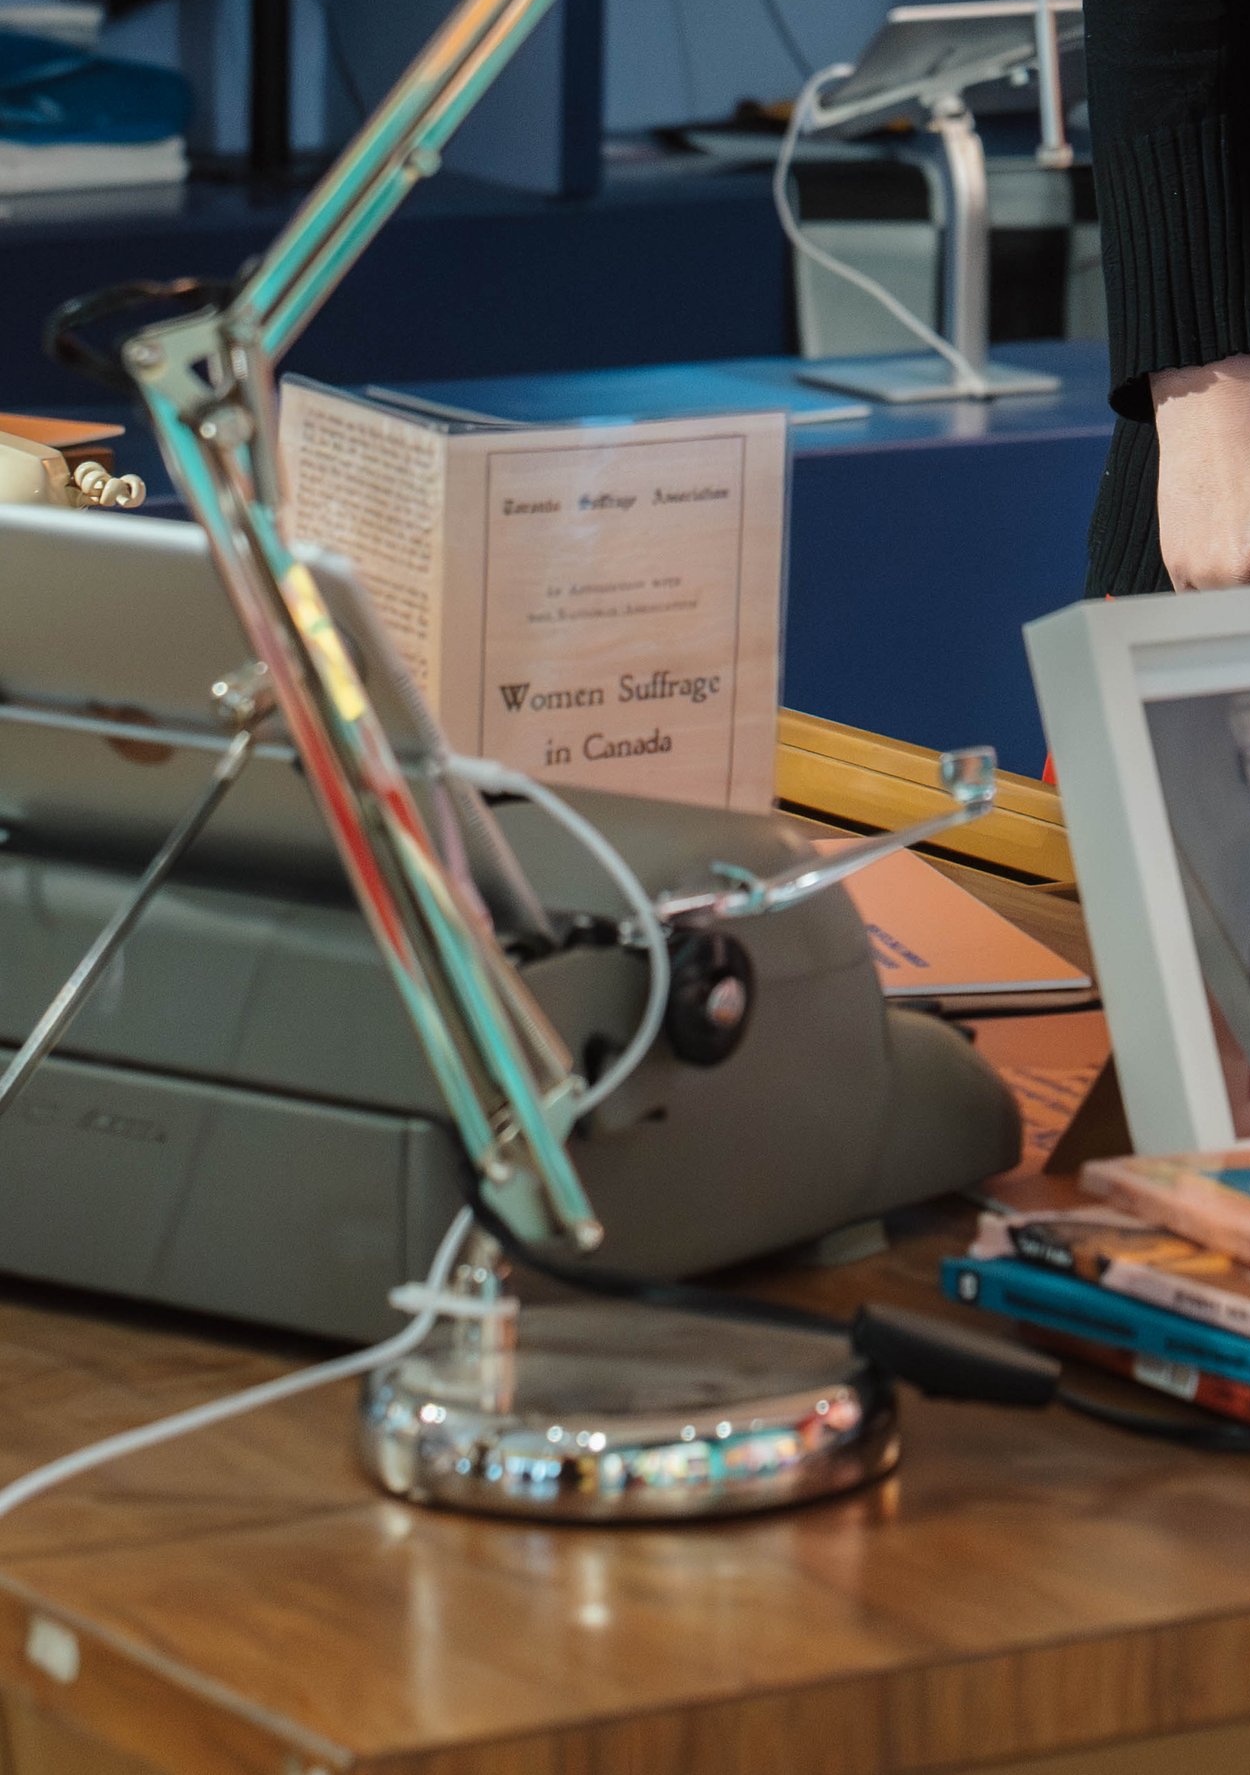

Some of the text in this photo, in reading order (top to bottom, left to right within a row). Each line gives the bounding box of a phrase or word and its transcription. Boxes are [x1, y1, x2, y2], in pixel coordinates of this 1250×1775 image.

[578, 492, 637, 512] Suffrage
[499, 671, 720, 712] Women Suffrage
[545, 728, 672, 766] in Canada
